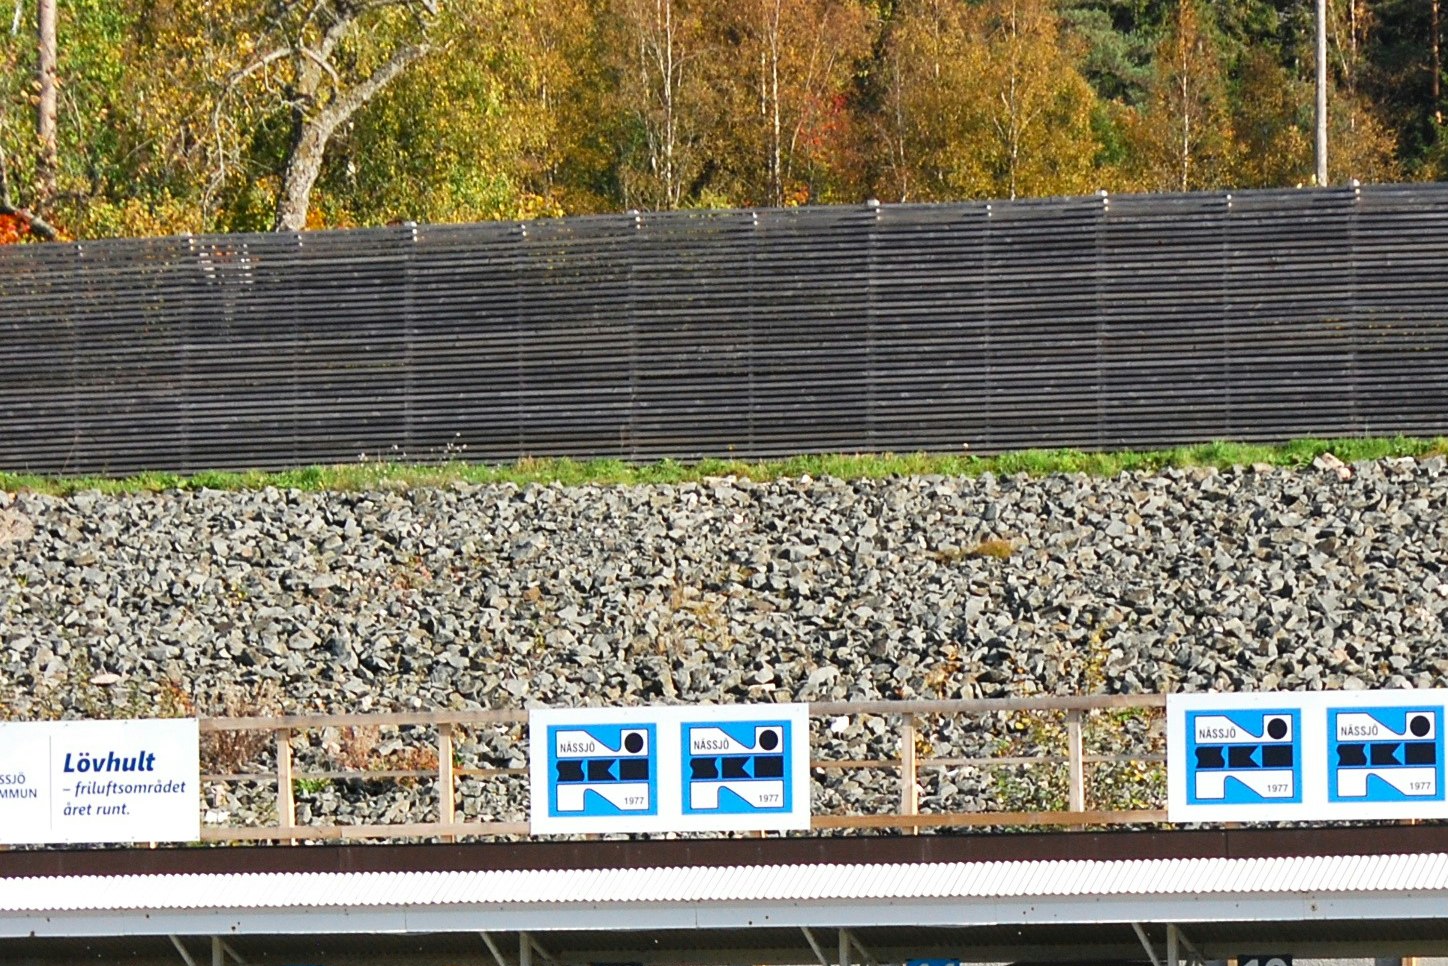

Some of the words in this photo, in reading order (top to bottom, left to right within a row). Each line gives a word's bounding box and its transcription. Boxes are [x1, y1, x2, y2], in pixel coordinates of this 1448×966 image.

[1199, 725, 1237, 739] NÄSSJÖ
[1340, 722, 1379, 736] NÄSSJÖ
[560, 741, 596, 753] NÄSSJÖ
[693, 738, 730, 750] NÄSSJÖ
[63, 750, 156, 773] Lövhult
[75, 780, 186, 797] friluftsområdet
[1267, 784, 1288, 793] 1977
[1409, 781, 1431, 791] 1977
[624, 796, 645, 805] 1977
[758, 793, 779, 803] 1977
[63, 803, 91, 815] året
[96, 804, 130, 815] runt.
